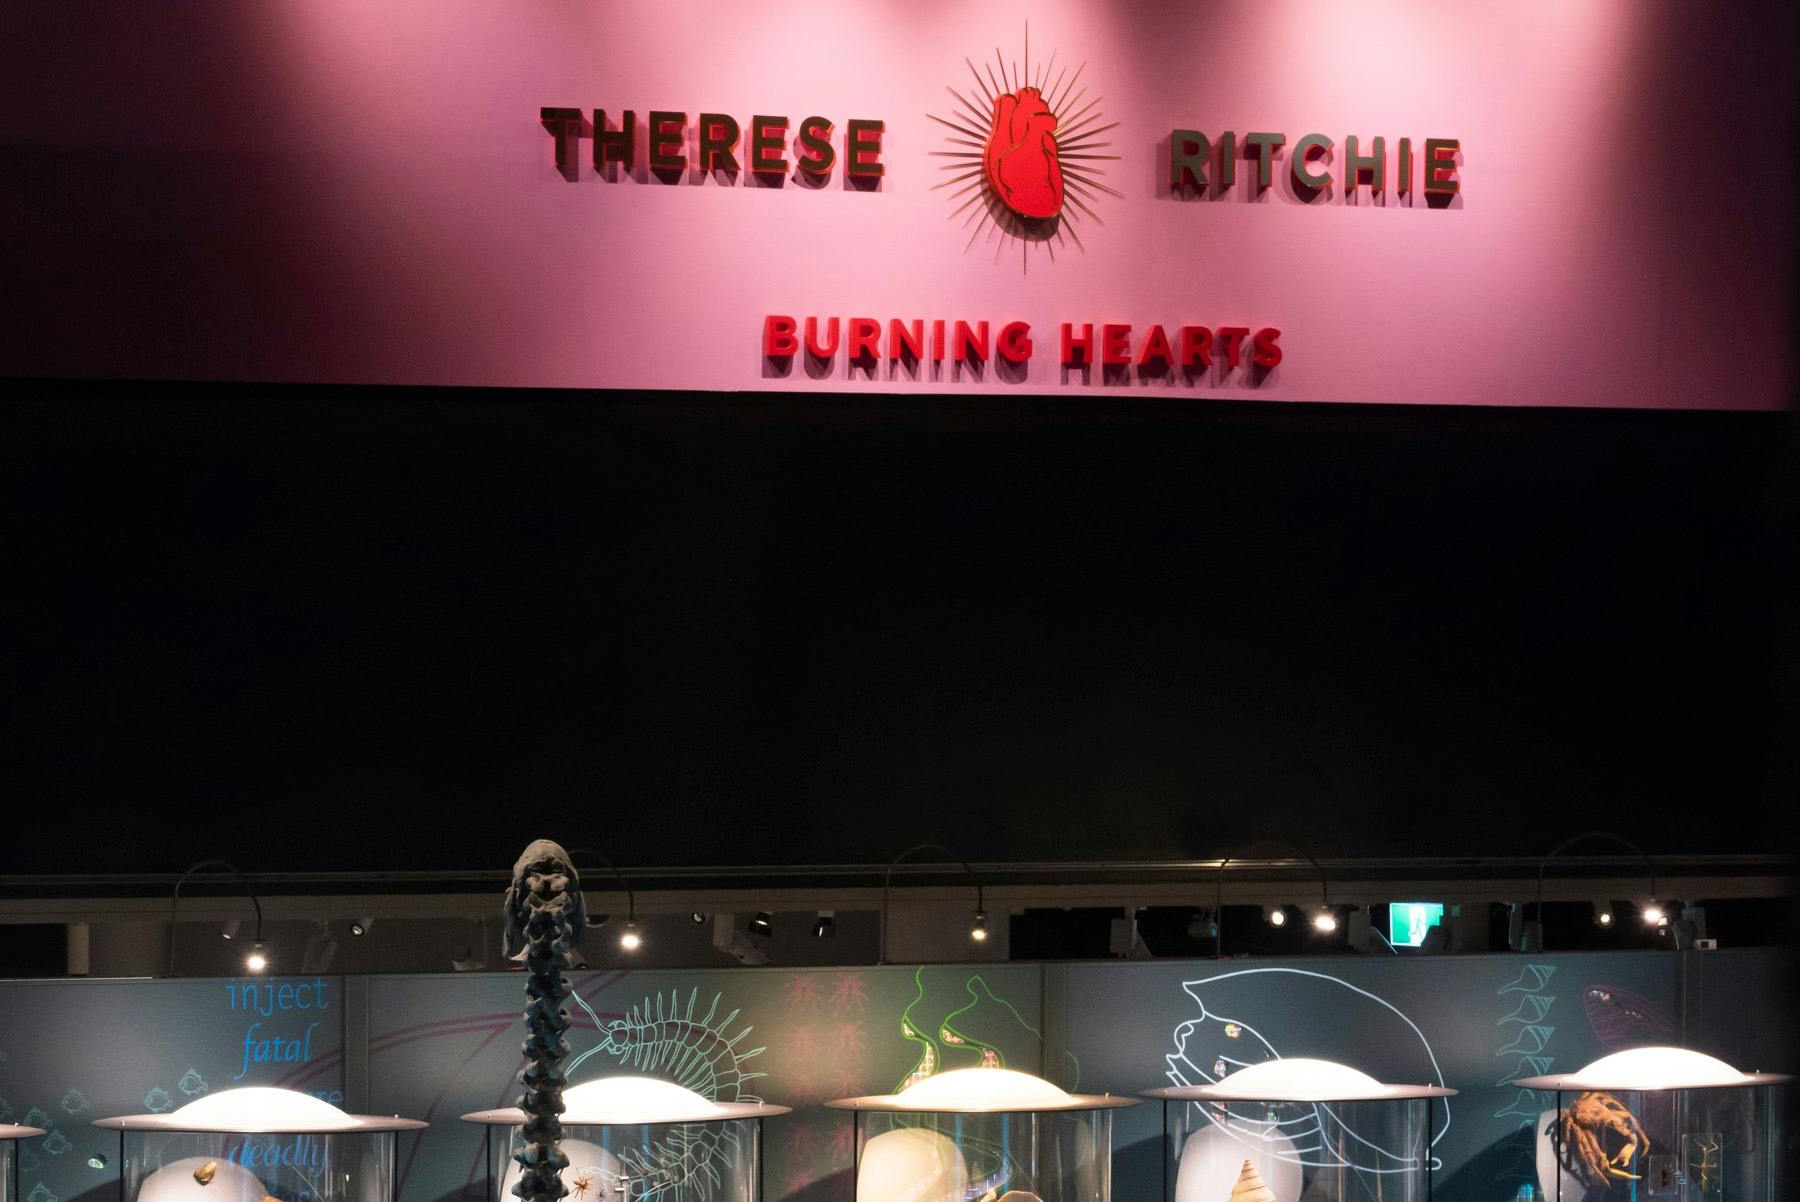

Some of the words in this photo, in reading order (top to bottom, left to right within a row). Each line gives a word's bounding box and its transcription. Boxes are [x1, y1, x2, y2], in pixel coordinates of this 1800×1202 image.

[540, 107, 885, 178] THERESE
[1170, 128, 1461, 194] RITCHIE
[763, 313, 1034, 363] BURNING
[1060, 322, 1284, 368] HEARTS
[226, 976, 329, 1016] inject
[232, 1022, 320, 1080] fatal
[227, 1134, 329, 1178] deadly
